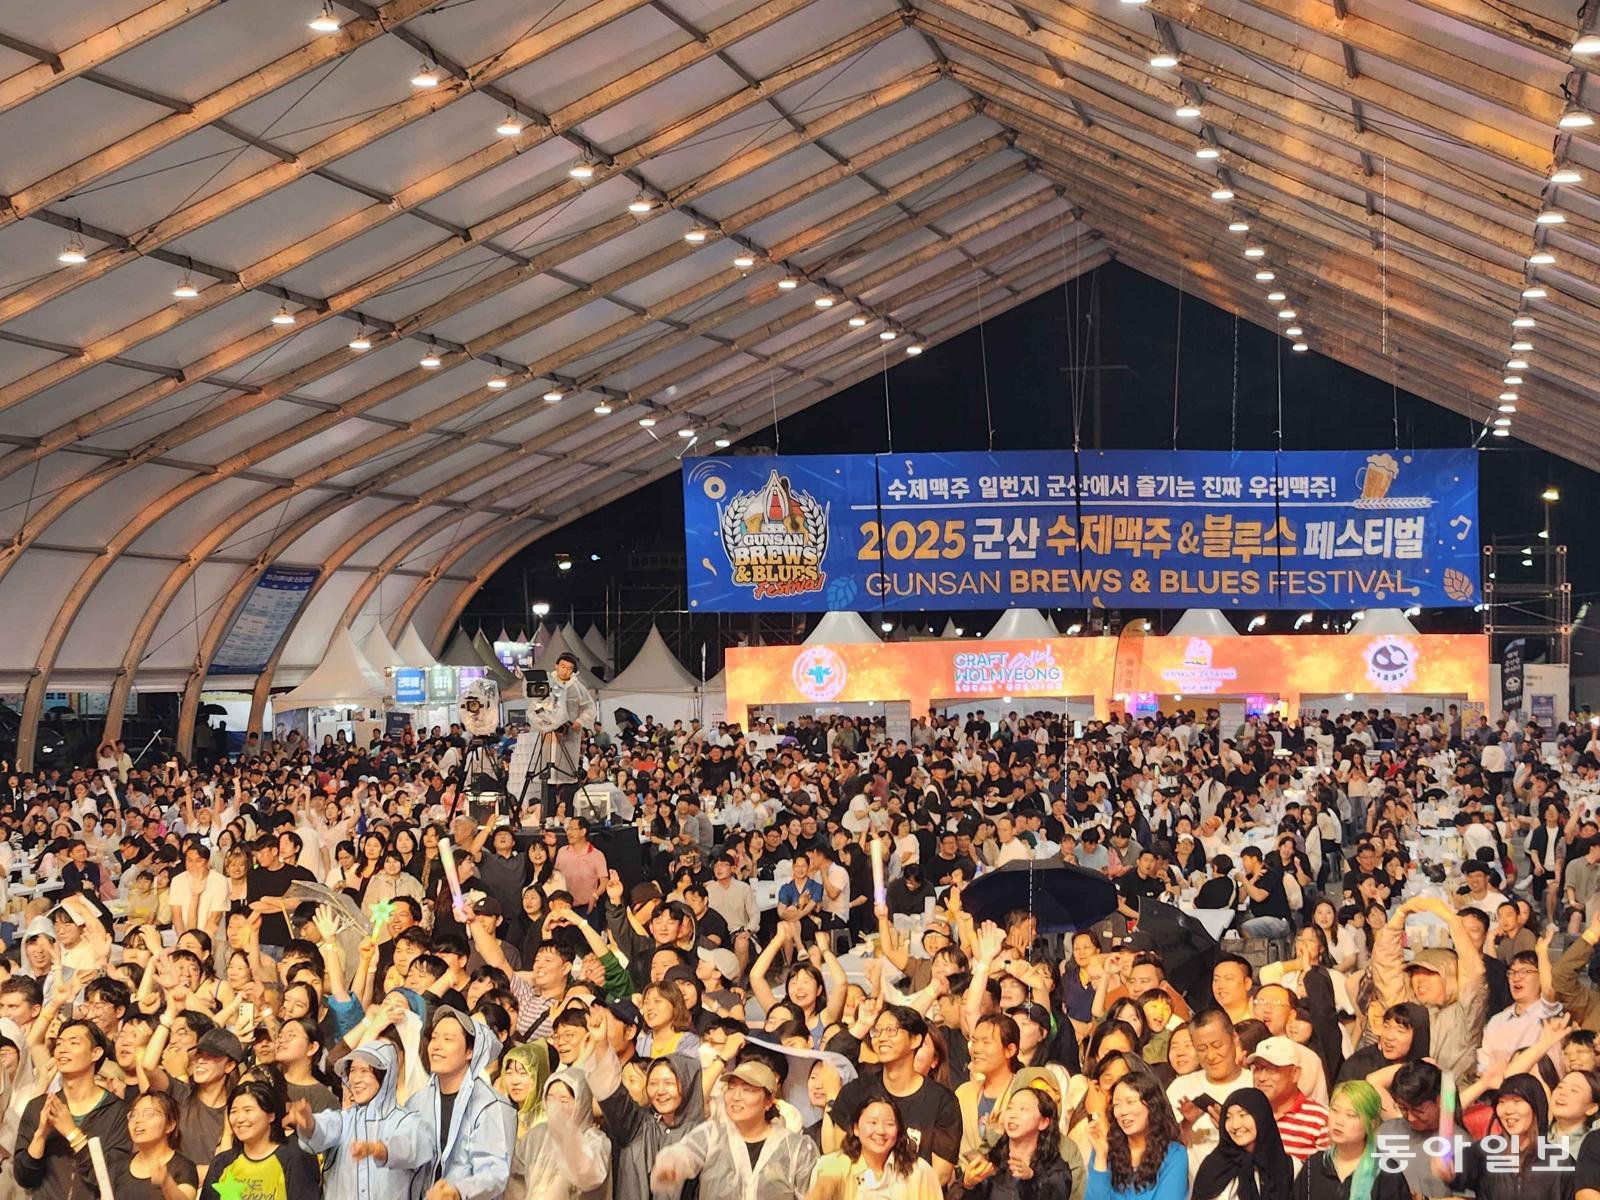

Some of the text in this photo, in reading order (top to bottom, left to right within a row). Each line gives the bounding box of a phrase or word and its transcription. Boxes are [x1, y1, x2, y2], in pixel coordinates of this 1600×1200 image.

[887, 474, 1337, 501] 수제맥주 일번지 군산에서 즐기는 진짜 우리맥주!
[743, 533, 804, 546] GUNSAN
[857, 520, 966, 561] 2025
[972, 517, 1041, 560] 군산
[1045, 514, 1172, 559] 수제맥주
[1302, 515, 1425, 560] 페스티벌
[734, 545, 818, 566] BREWS
[865, 568, 1412, 597] GUNSAN BREWS & BLUES FESTIVAL
[954, 653, 1009, 668] CRAFT
[955, 666, 1061, 682] WOLMYEONG
